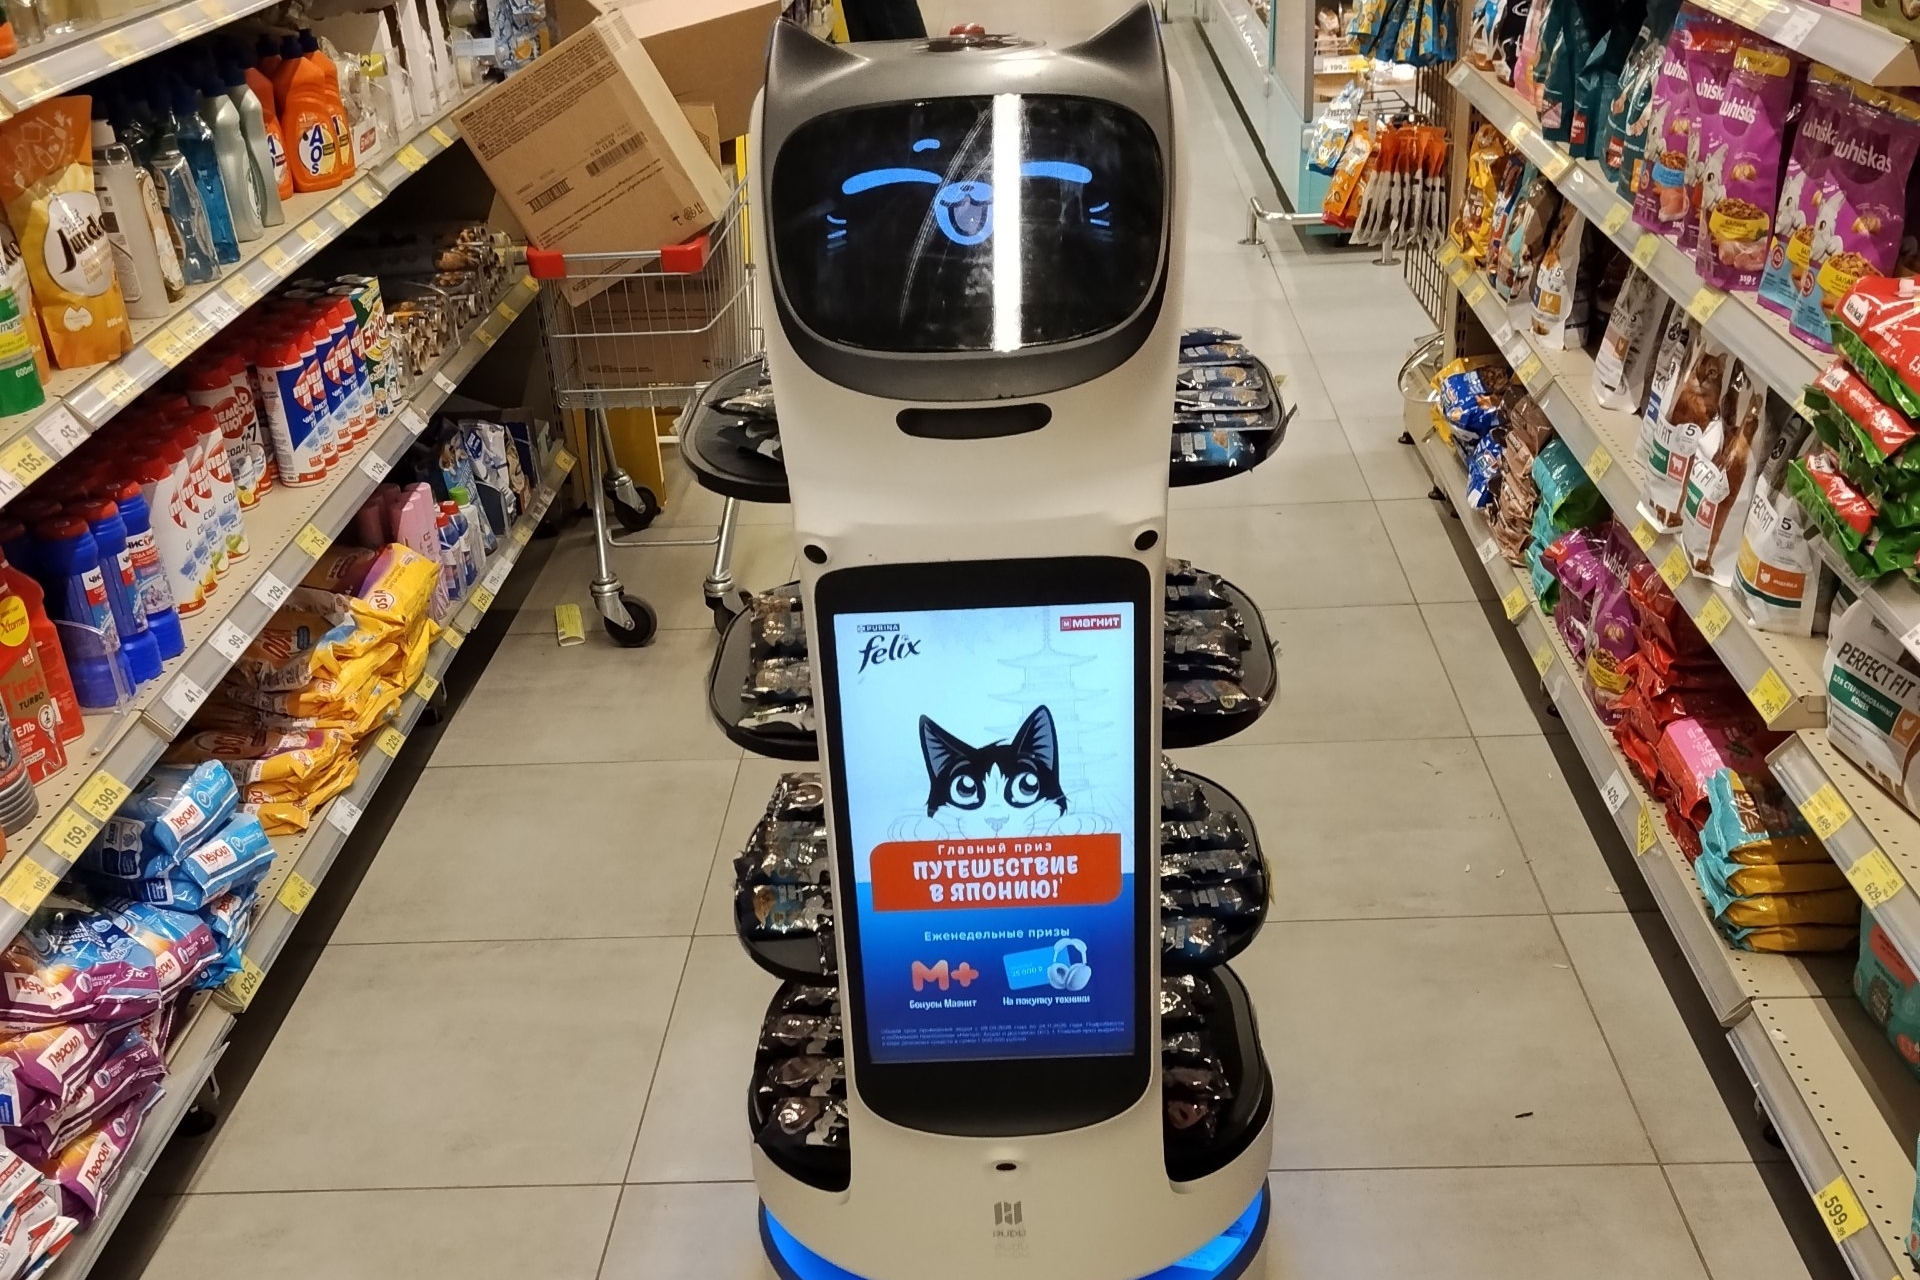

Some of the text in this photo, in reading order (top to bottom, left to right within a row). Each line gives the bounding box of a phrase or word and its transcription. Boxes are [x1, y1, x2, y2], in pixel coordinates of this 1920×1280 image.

[1834, 138, 1892, 174] whiskas
[1685, 424, 1697, 437] 5
[1781, 516, 1793, 531] 5
[1836, 641, 1917, 700] PERFECT FIT
[19, 691, 45, 710] TURBO
[937, 841, 1052, 856] Главный приз
[912, 855, 1079, 880] ПУТЕШЕСТВИЕ
[929, 884, 944, 902] В
[924, 928, 1070, 942] Еженедельные призы
[48, 1035, 81, 1068] Персил
[85, 1142, 112, 1185] Персил
[1823, 1194, 1848, 1239] 599.99
